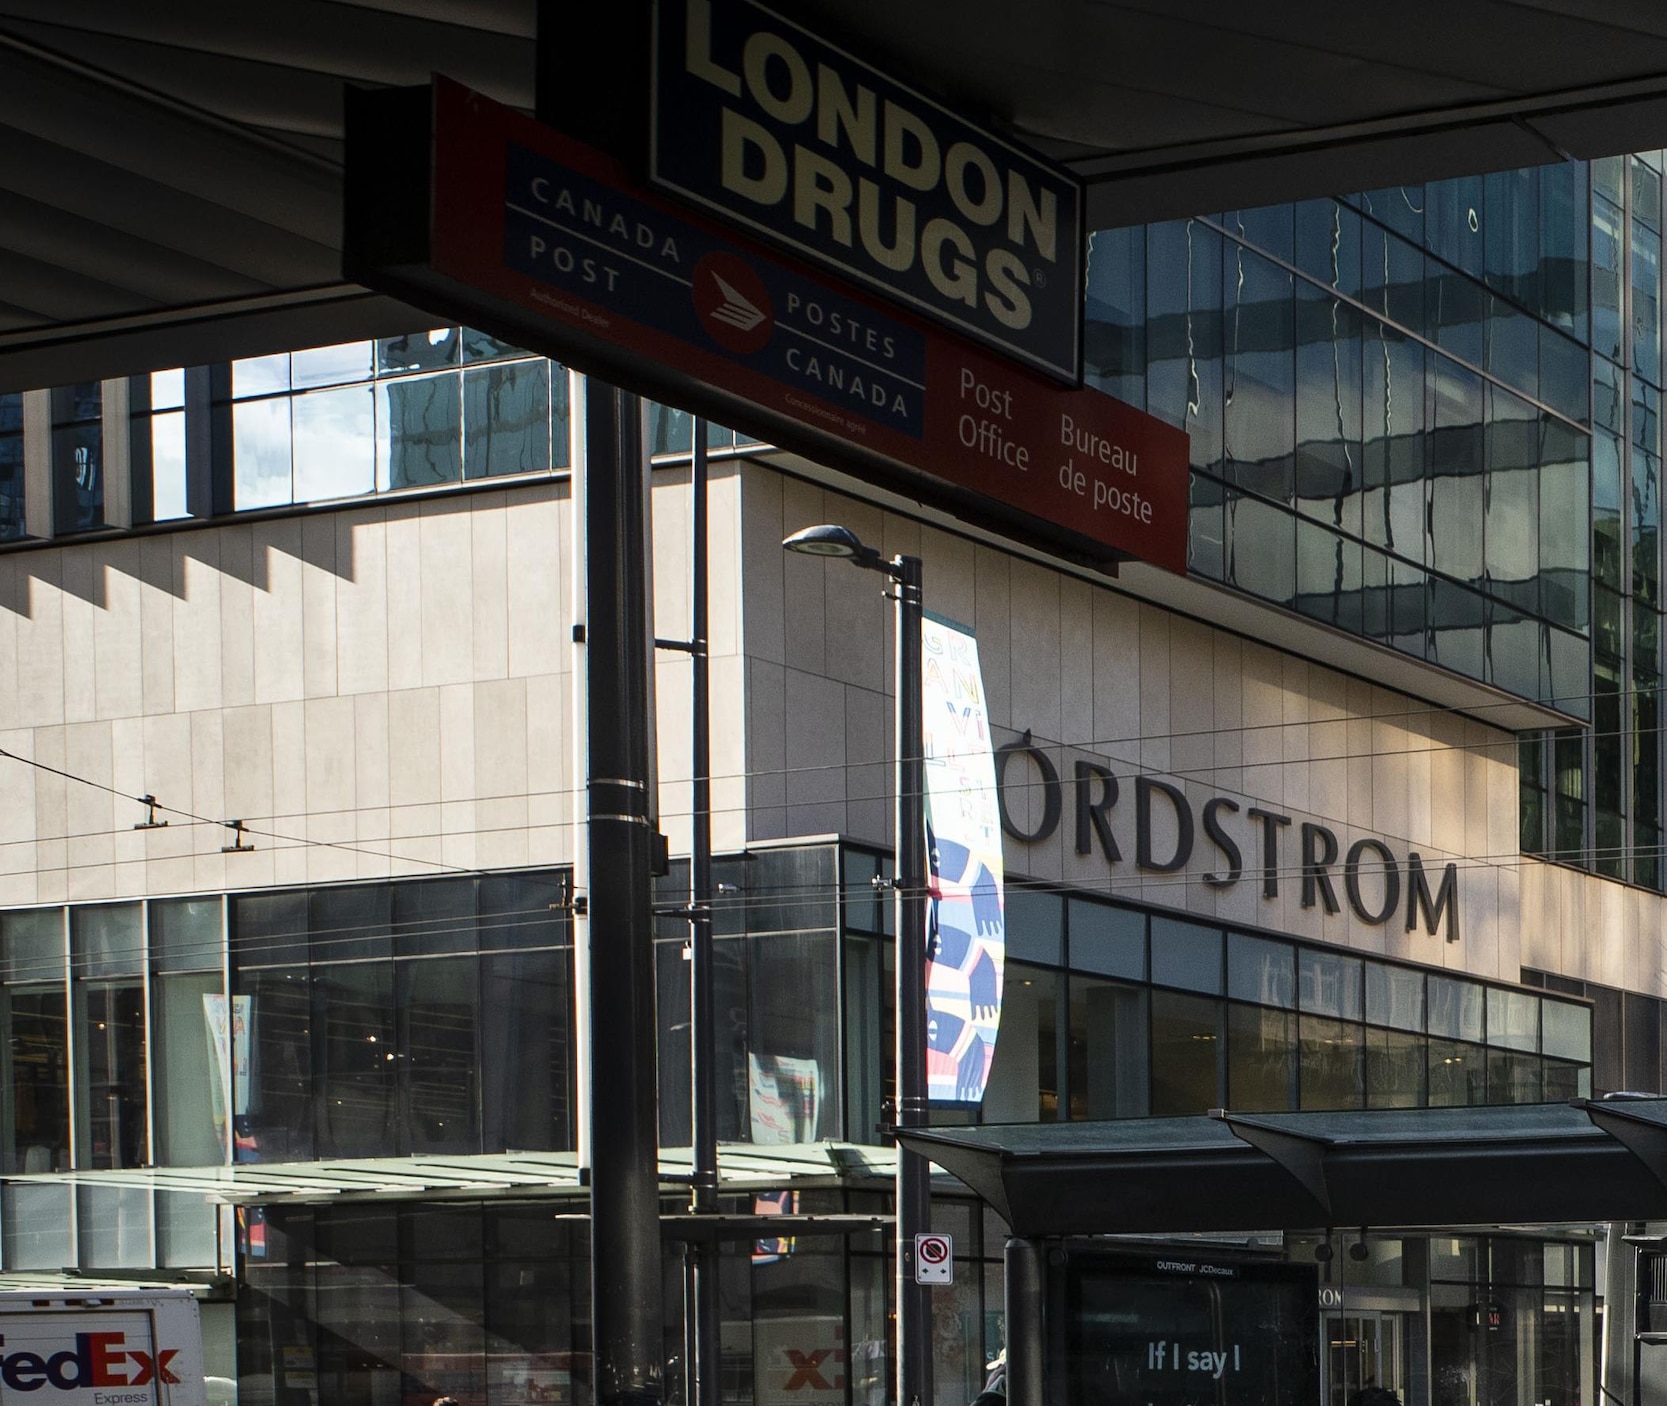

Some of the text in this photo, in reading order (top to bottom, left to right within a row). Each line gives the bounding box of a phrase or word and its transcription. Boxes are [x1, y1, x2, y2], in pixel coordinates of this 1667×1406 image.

[685, 0, 1057, 264] LONDON
[530, 177, 681, 263] CANADA
[721, 106, 1033, 330] DRUGS
[530, 234, 621, 292] POST
[787, 292, 896, 360] POSTES
[785, 347, 908, 418] CANADA
[960, 368, 1013, 421] Post
[959, 415, 1030, 472] Office
[1060, 414, 1138, 477] Bureau
[1059, 458, 1153, 525] de poste
[998, 732, 1459, 943] ORDSTROM
[1156, 1259, 1235, 1277] OUTFRONT JCDecaux
[0, 1331, 181, 1392] edEx
[1148, 1339, 1241, 1380] If I say I
[94, 1391, 148, 1406] Express
